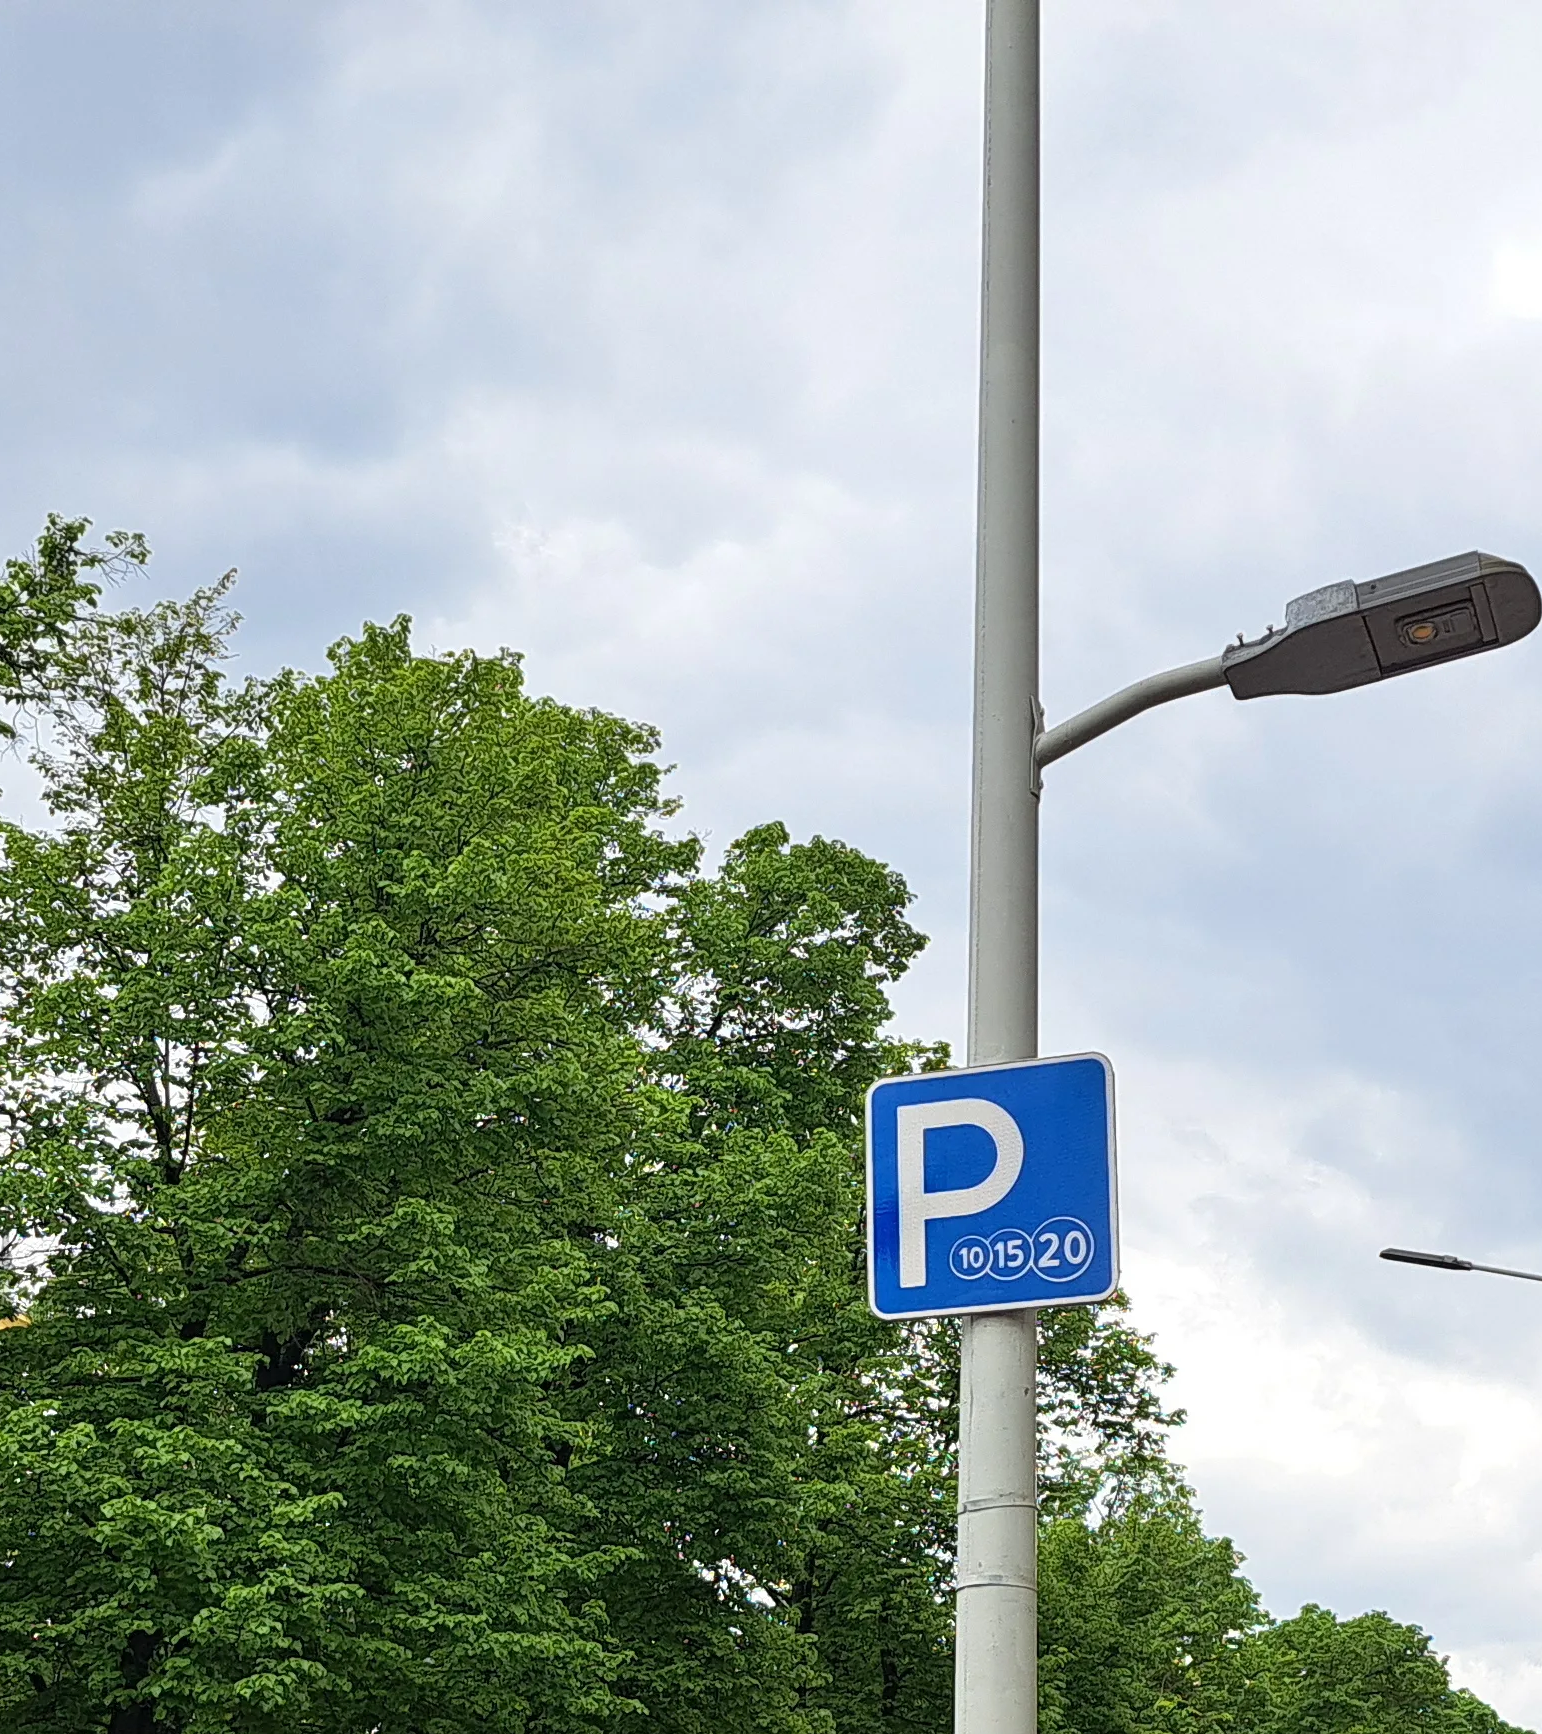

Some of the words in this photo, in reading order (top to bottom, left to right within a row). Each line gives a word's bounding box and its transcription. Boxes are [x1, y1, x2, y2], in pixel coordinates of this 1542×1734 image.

[896, 1097, 1025, 1289] P
[958, 1246, 985, 1270] 10
[993, 1239, 1024, 1269] 15
[1037, 1229, 1087, 1269] 20
